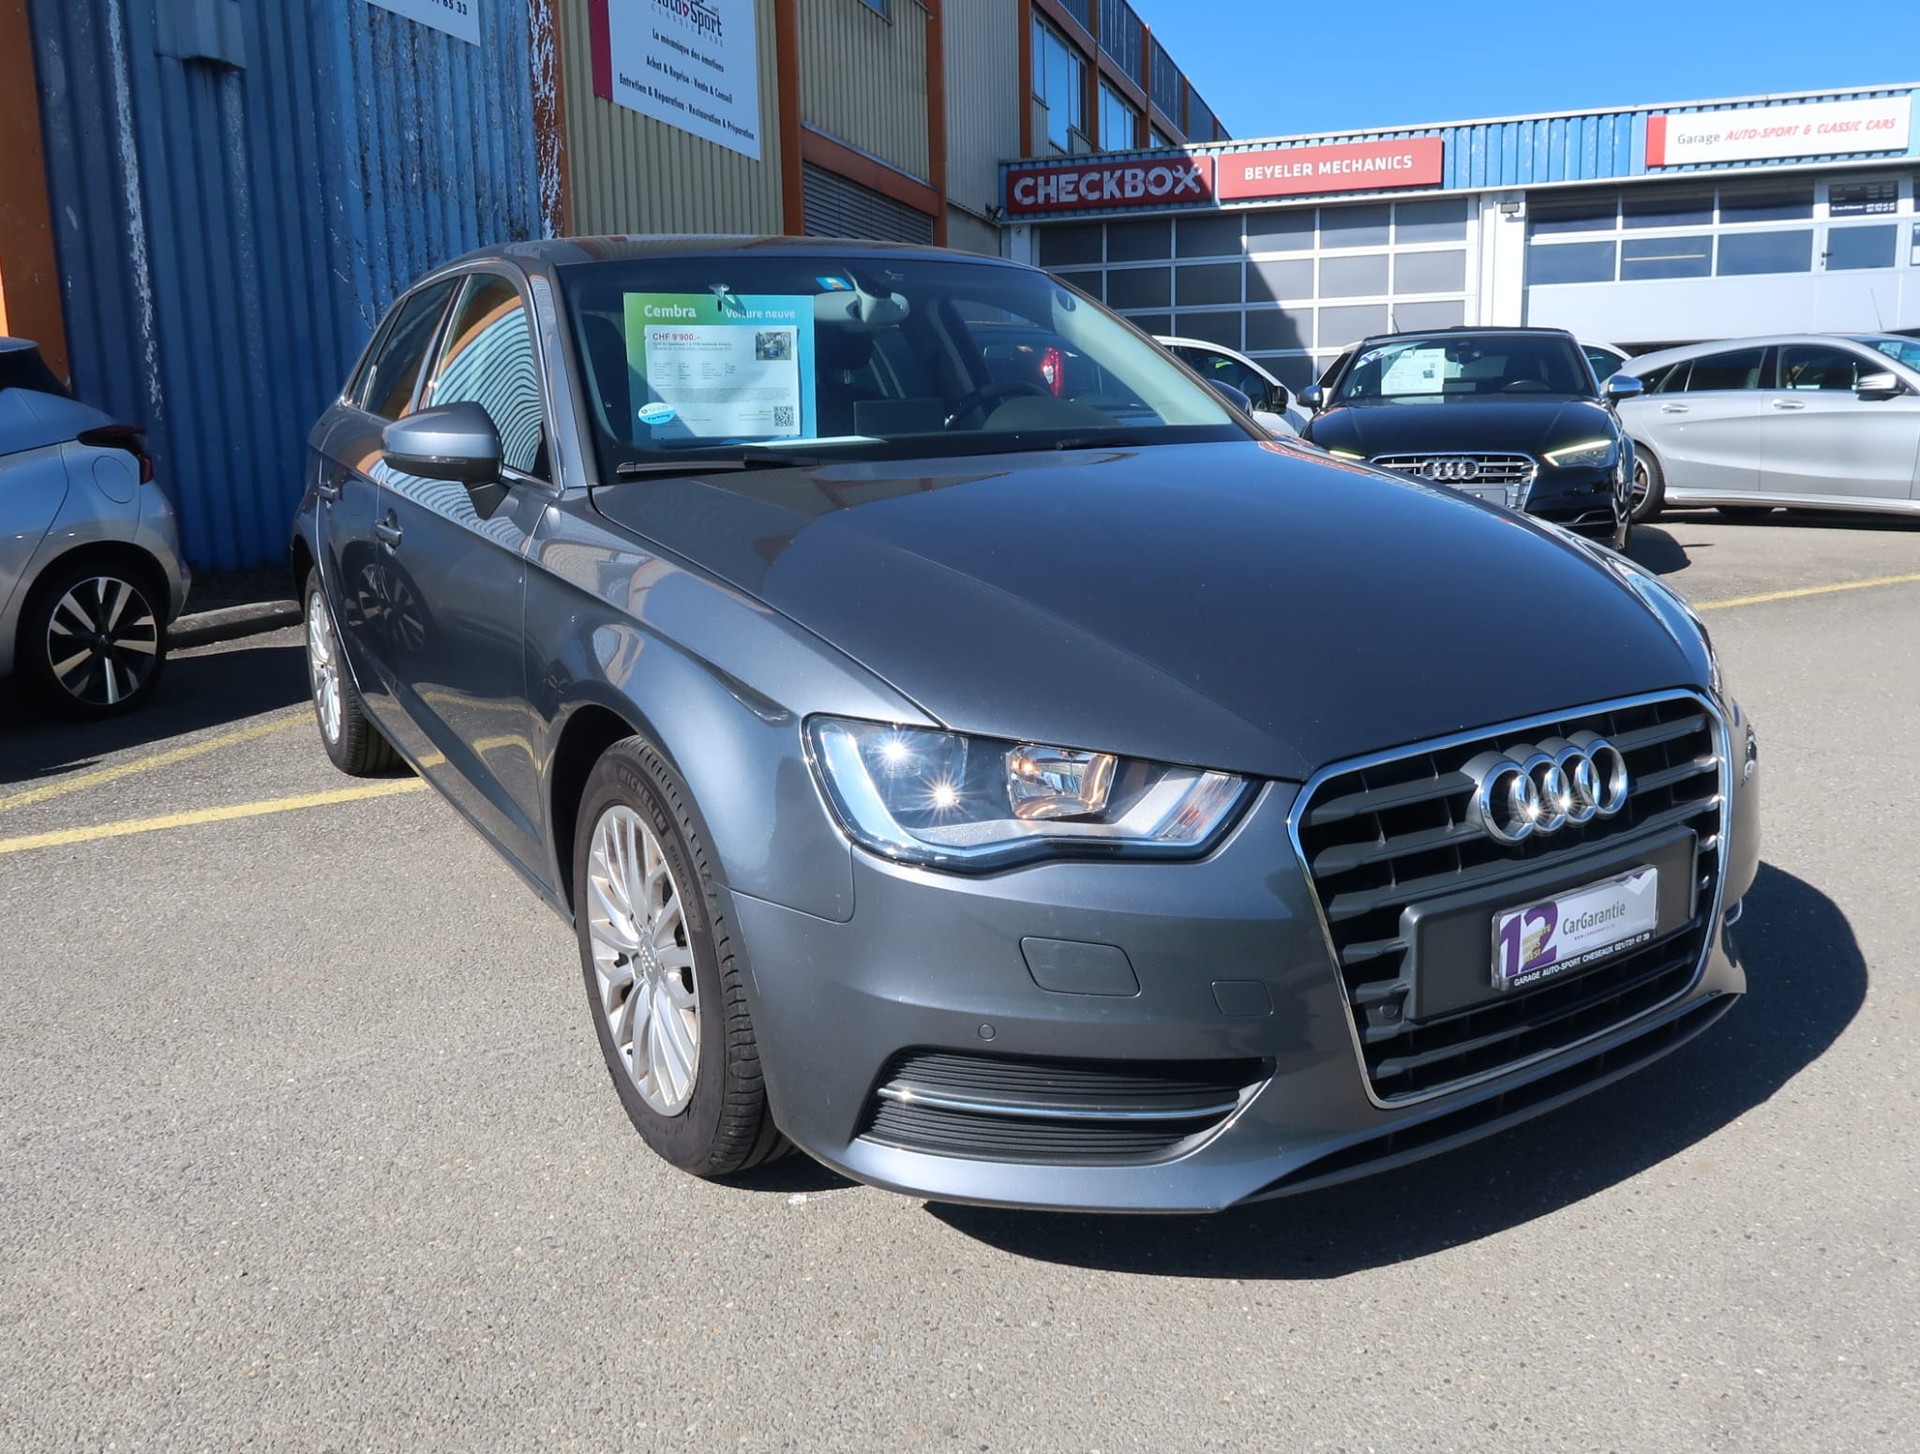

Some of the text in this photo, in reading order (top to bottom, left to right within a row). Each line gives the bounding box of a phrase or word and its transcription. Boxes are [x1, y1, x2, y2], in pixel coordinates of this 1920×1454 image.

[456, 1, 467, 16] 33
[690, 1, 723, 37] Sport
[652, 28, 660, 40] La
[690, 47, 701, 61] des
[646, 54, 733, 104] Achat & Reprise Vente & Conseil
[619, 72, 755, 141] Entretien & Réparation Restauration & Préparation
[1677, 117, 1897, 146] Garage AUTO-SPORT & CLASSIC CARS
[1013, 163, 1203, 206] CHECKBOX
[1244, 154, 1414, 181] BEYELER MECHANICS
[644, 304, 697, 319] Cembra
[765, 309, 796, 320] neuve
[653, 333, 671, 341] CHF
[617, 767, 668, 835] MICHELIN
[669, 843, 695, 908] PRIMACY
[1562, 900, 1626, 936] CarGarantie
[1500, 902, 1559, 978] 12
[1514, 970, 1541, 987] GARAGE
[1541, 957, 1582, 978] AUTO-SPORT
[1582, 946, 1614, 963] CHESEAUX
